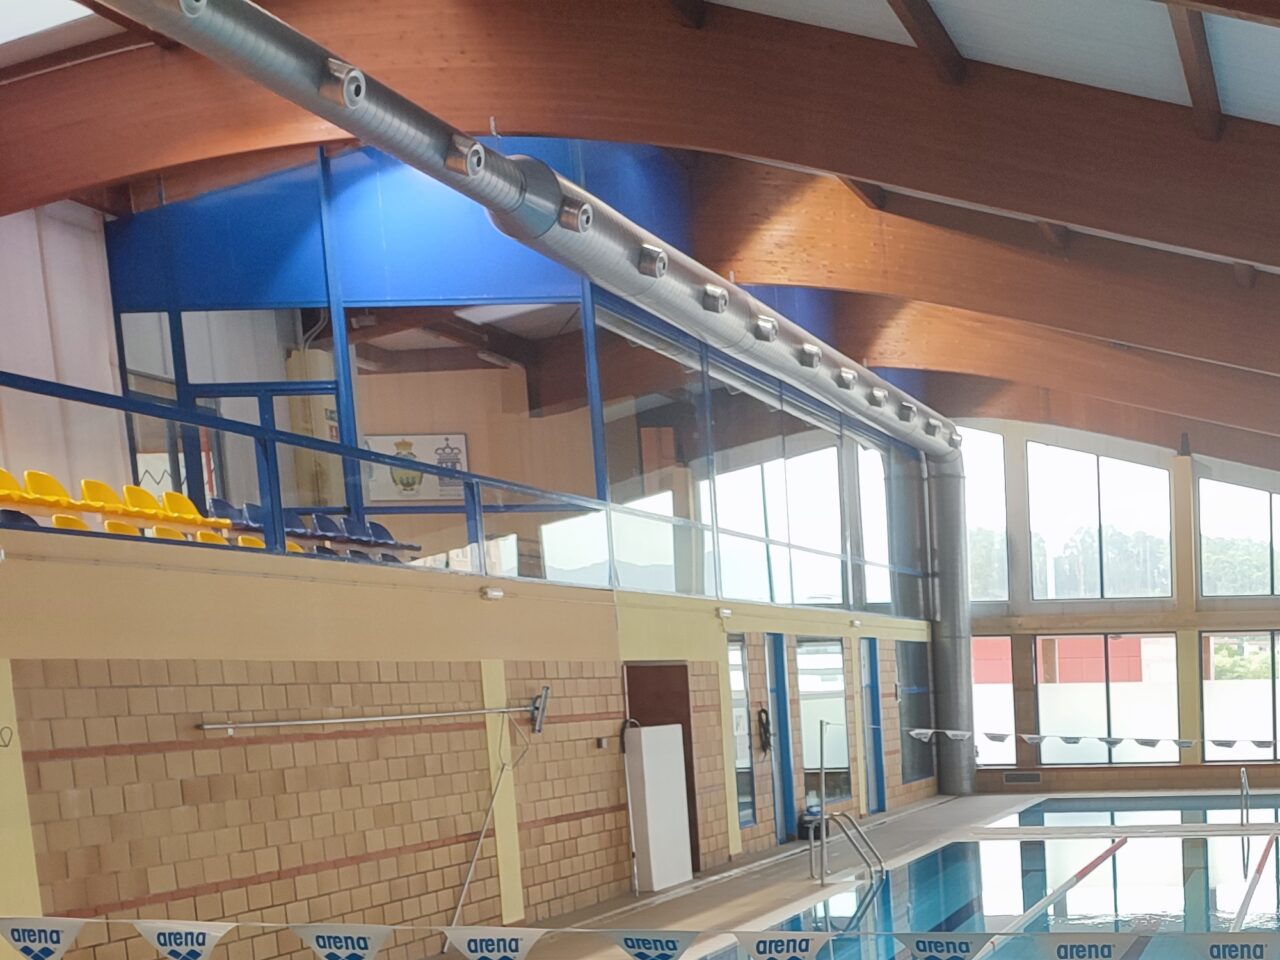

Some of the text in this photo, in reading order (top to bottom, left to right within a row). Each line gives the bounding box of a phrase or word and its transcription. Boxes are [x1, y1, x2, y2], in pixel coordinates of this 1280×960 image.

[10, 928, 60, 945] arena
[156, 930, 207, 947] arena
[315, 933, 368, 951] arena
[467, 936, 519, 954] arena
[624, 936, 678, 951] arena
[756, 937, 809, 954] arena
[915, 939, 970, 954] arena
[1057, 944, 1112, 959] arena
[1210, 944, 1264, 960] arena
